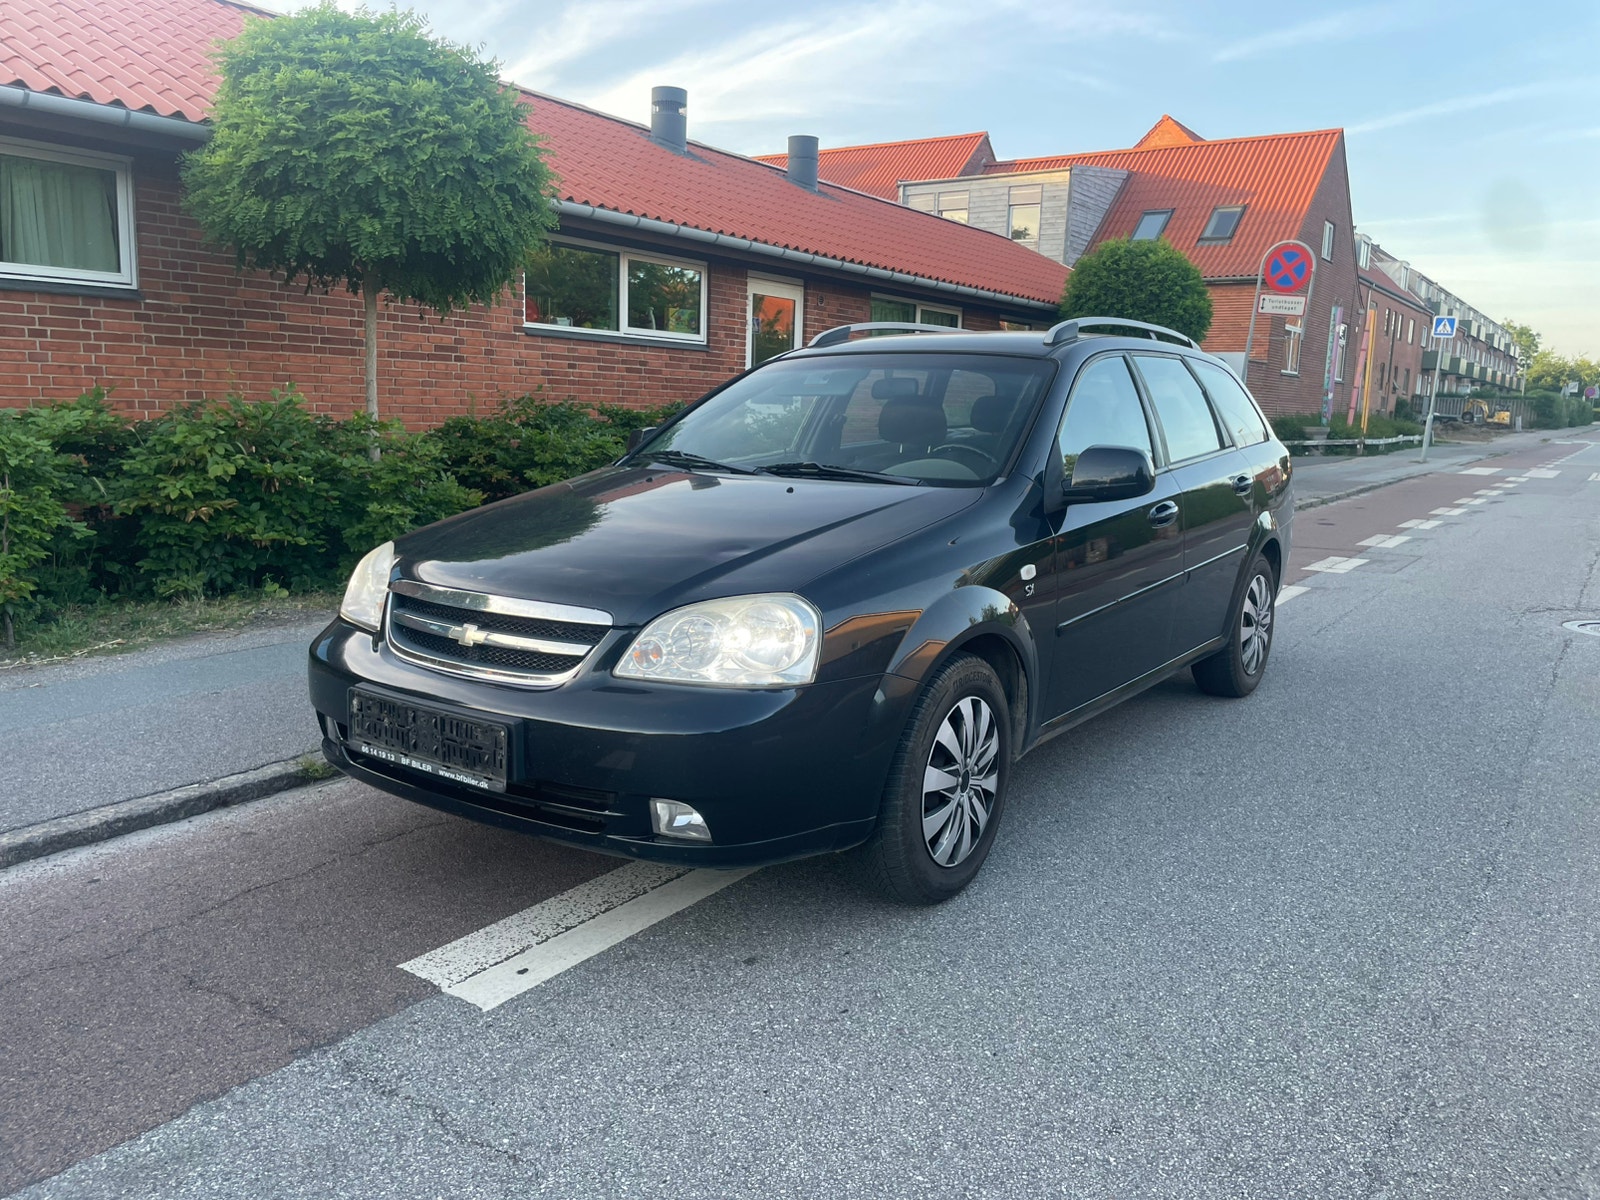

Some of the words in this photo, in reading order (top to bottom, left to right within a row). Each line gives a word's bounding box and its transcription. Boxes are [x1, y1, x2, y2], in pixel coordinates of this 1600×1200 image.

[1025, 583, 1035, 597] SX
[401, 757, 410, 765] BF
[412, 760, 432, 772] BILER
[438, 769, 489, 789] www.bfbiler.dk
